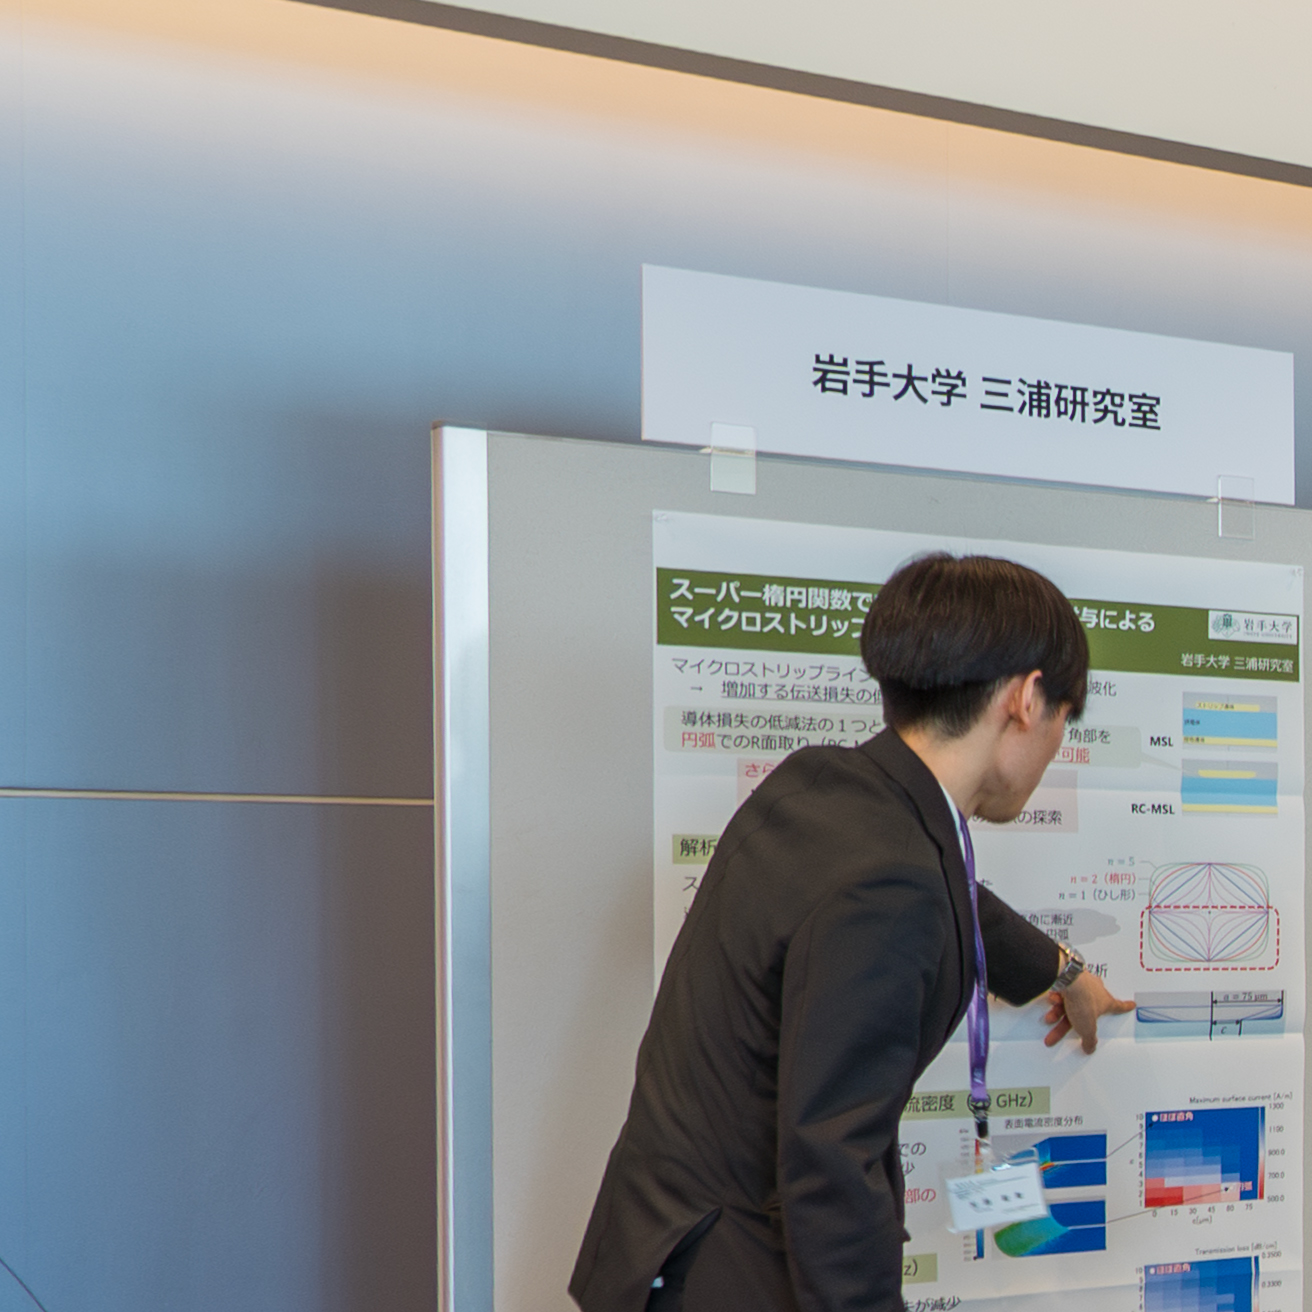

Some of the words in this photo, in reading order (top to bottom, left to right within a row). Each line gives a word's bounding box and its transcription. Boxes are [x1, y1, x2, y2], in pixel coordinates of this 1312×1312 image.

[812, 353, 967, 407] 岩手大学
[979, 376, 1161, 430] 三浦研究室
[670, 578, 880, 613] スーパー楕円関数で
[1073, 606, 1155, 632] 与による
[1244, 618, 1292, 633] 岩手大学
[671, 657, 873, 682] マイクロストリップライン
[1181, 653, 1230, 669] 岩手大学
[1234, 656, 1293, 673] 三浦研究室
[1150, 736, 1174, 747] MSL
[1057, 747, 1090, 764] 可能
[1014, 810, 1062, 825] の探索
[1131, 804, 1175, 815] RC-MSL
[680, 838, 717, 857] 解析
[1022, 913, 1073, 926] 角に漸近
